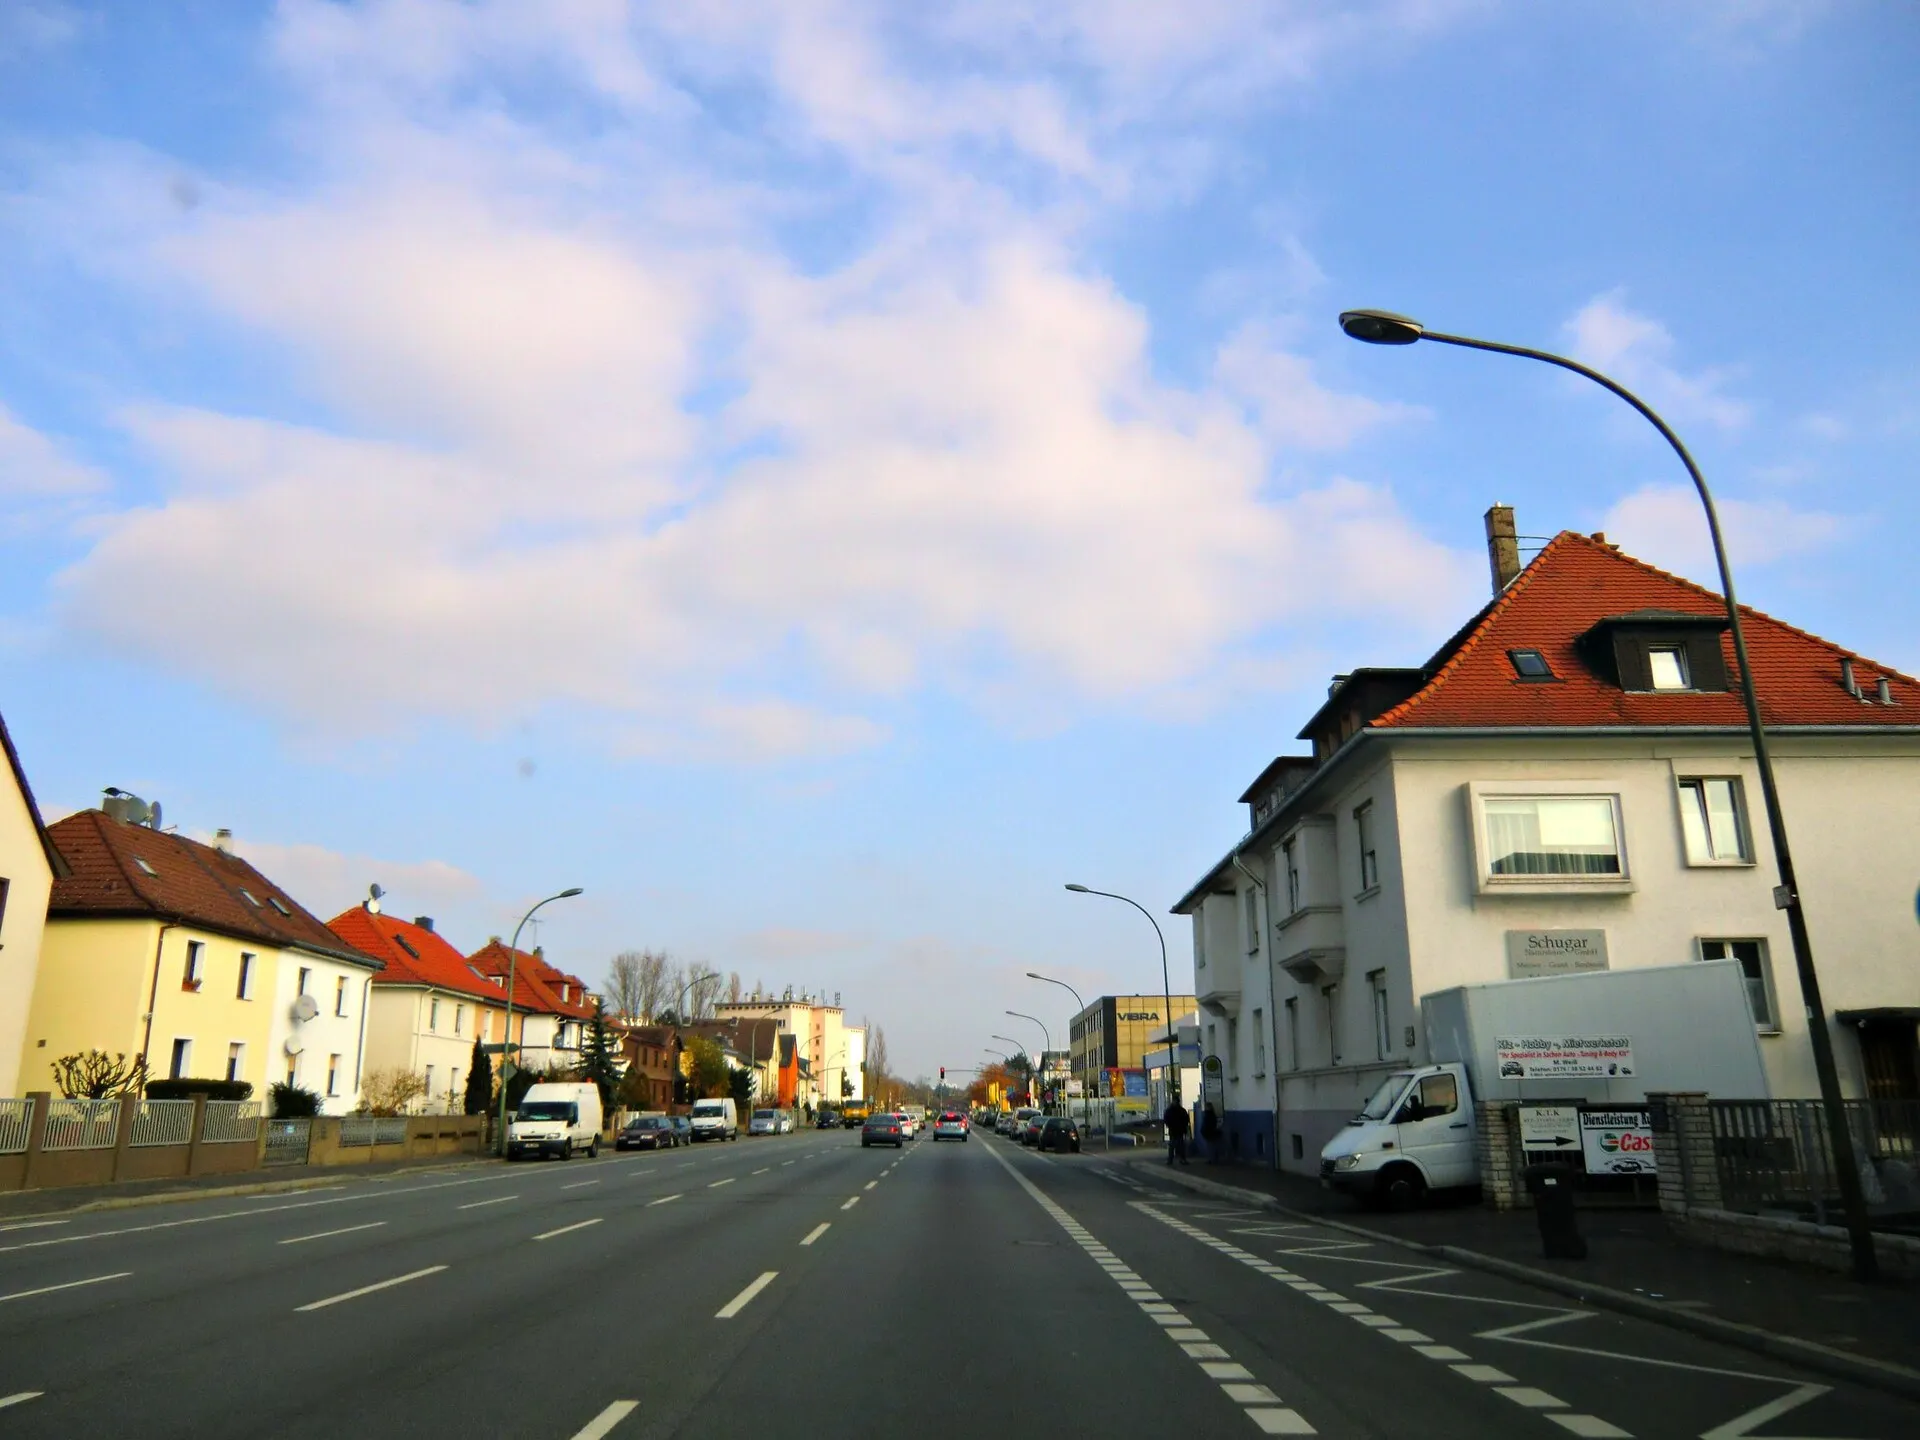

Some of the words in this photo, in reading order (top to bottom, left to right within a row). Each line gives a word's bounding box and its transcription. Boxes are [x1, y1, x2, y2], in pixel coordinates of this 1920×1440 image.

[1528, 935, 1588, 952] Schugar
[1117, 1012, 1160, 1021] VIBRA
[1520, 1038, 1552, 1050] Hobby
[1583, 1113, 1639, 1127] Dienstleistung
[1620, 1133, 1654, 1152] Cas
